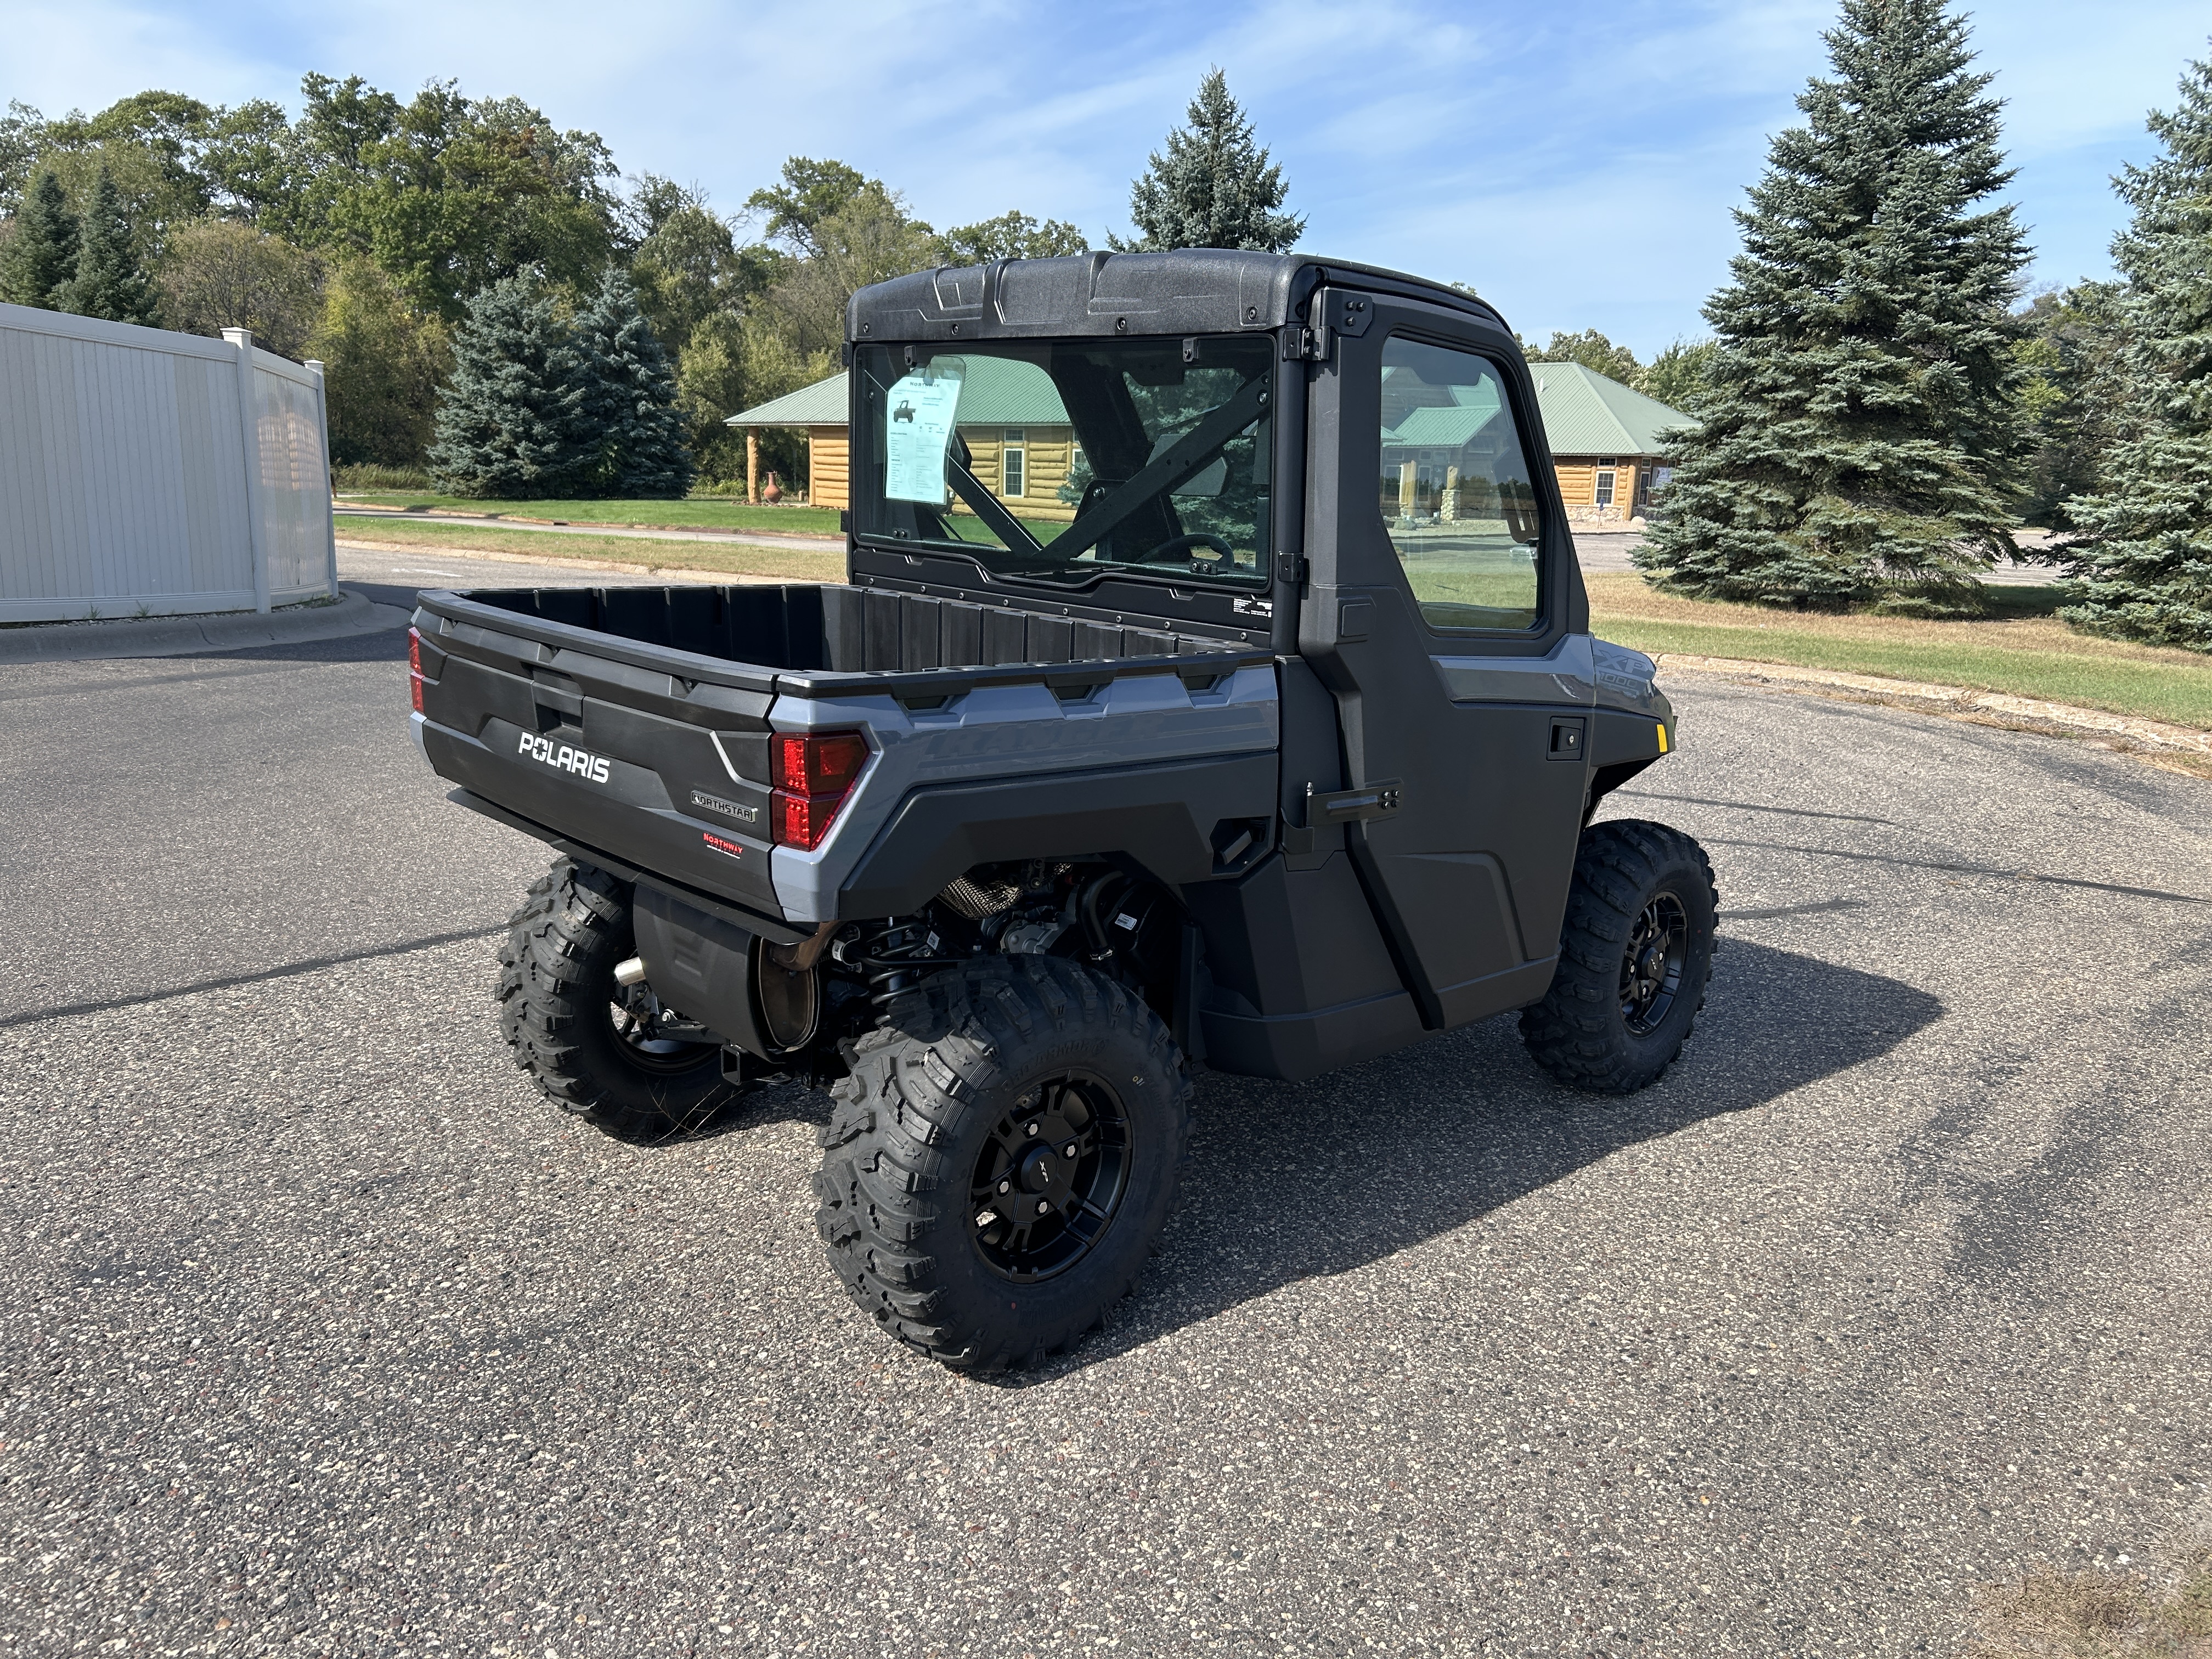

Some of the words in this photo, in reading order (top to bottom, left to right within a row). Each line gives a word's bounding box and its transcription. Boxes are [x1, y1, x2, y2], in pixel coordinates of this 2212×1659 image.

[1595, 649, 1649, 673] XP
[1599, 671, 1638, 688] 1000
[518, 731, 611, 783] POLARIS
[693, 794, 751, 819] NORTHSTAR
[703, 832, 743, 854] NORTHWAY
